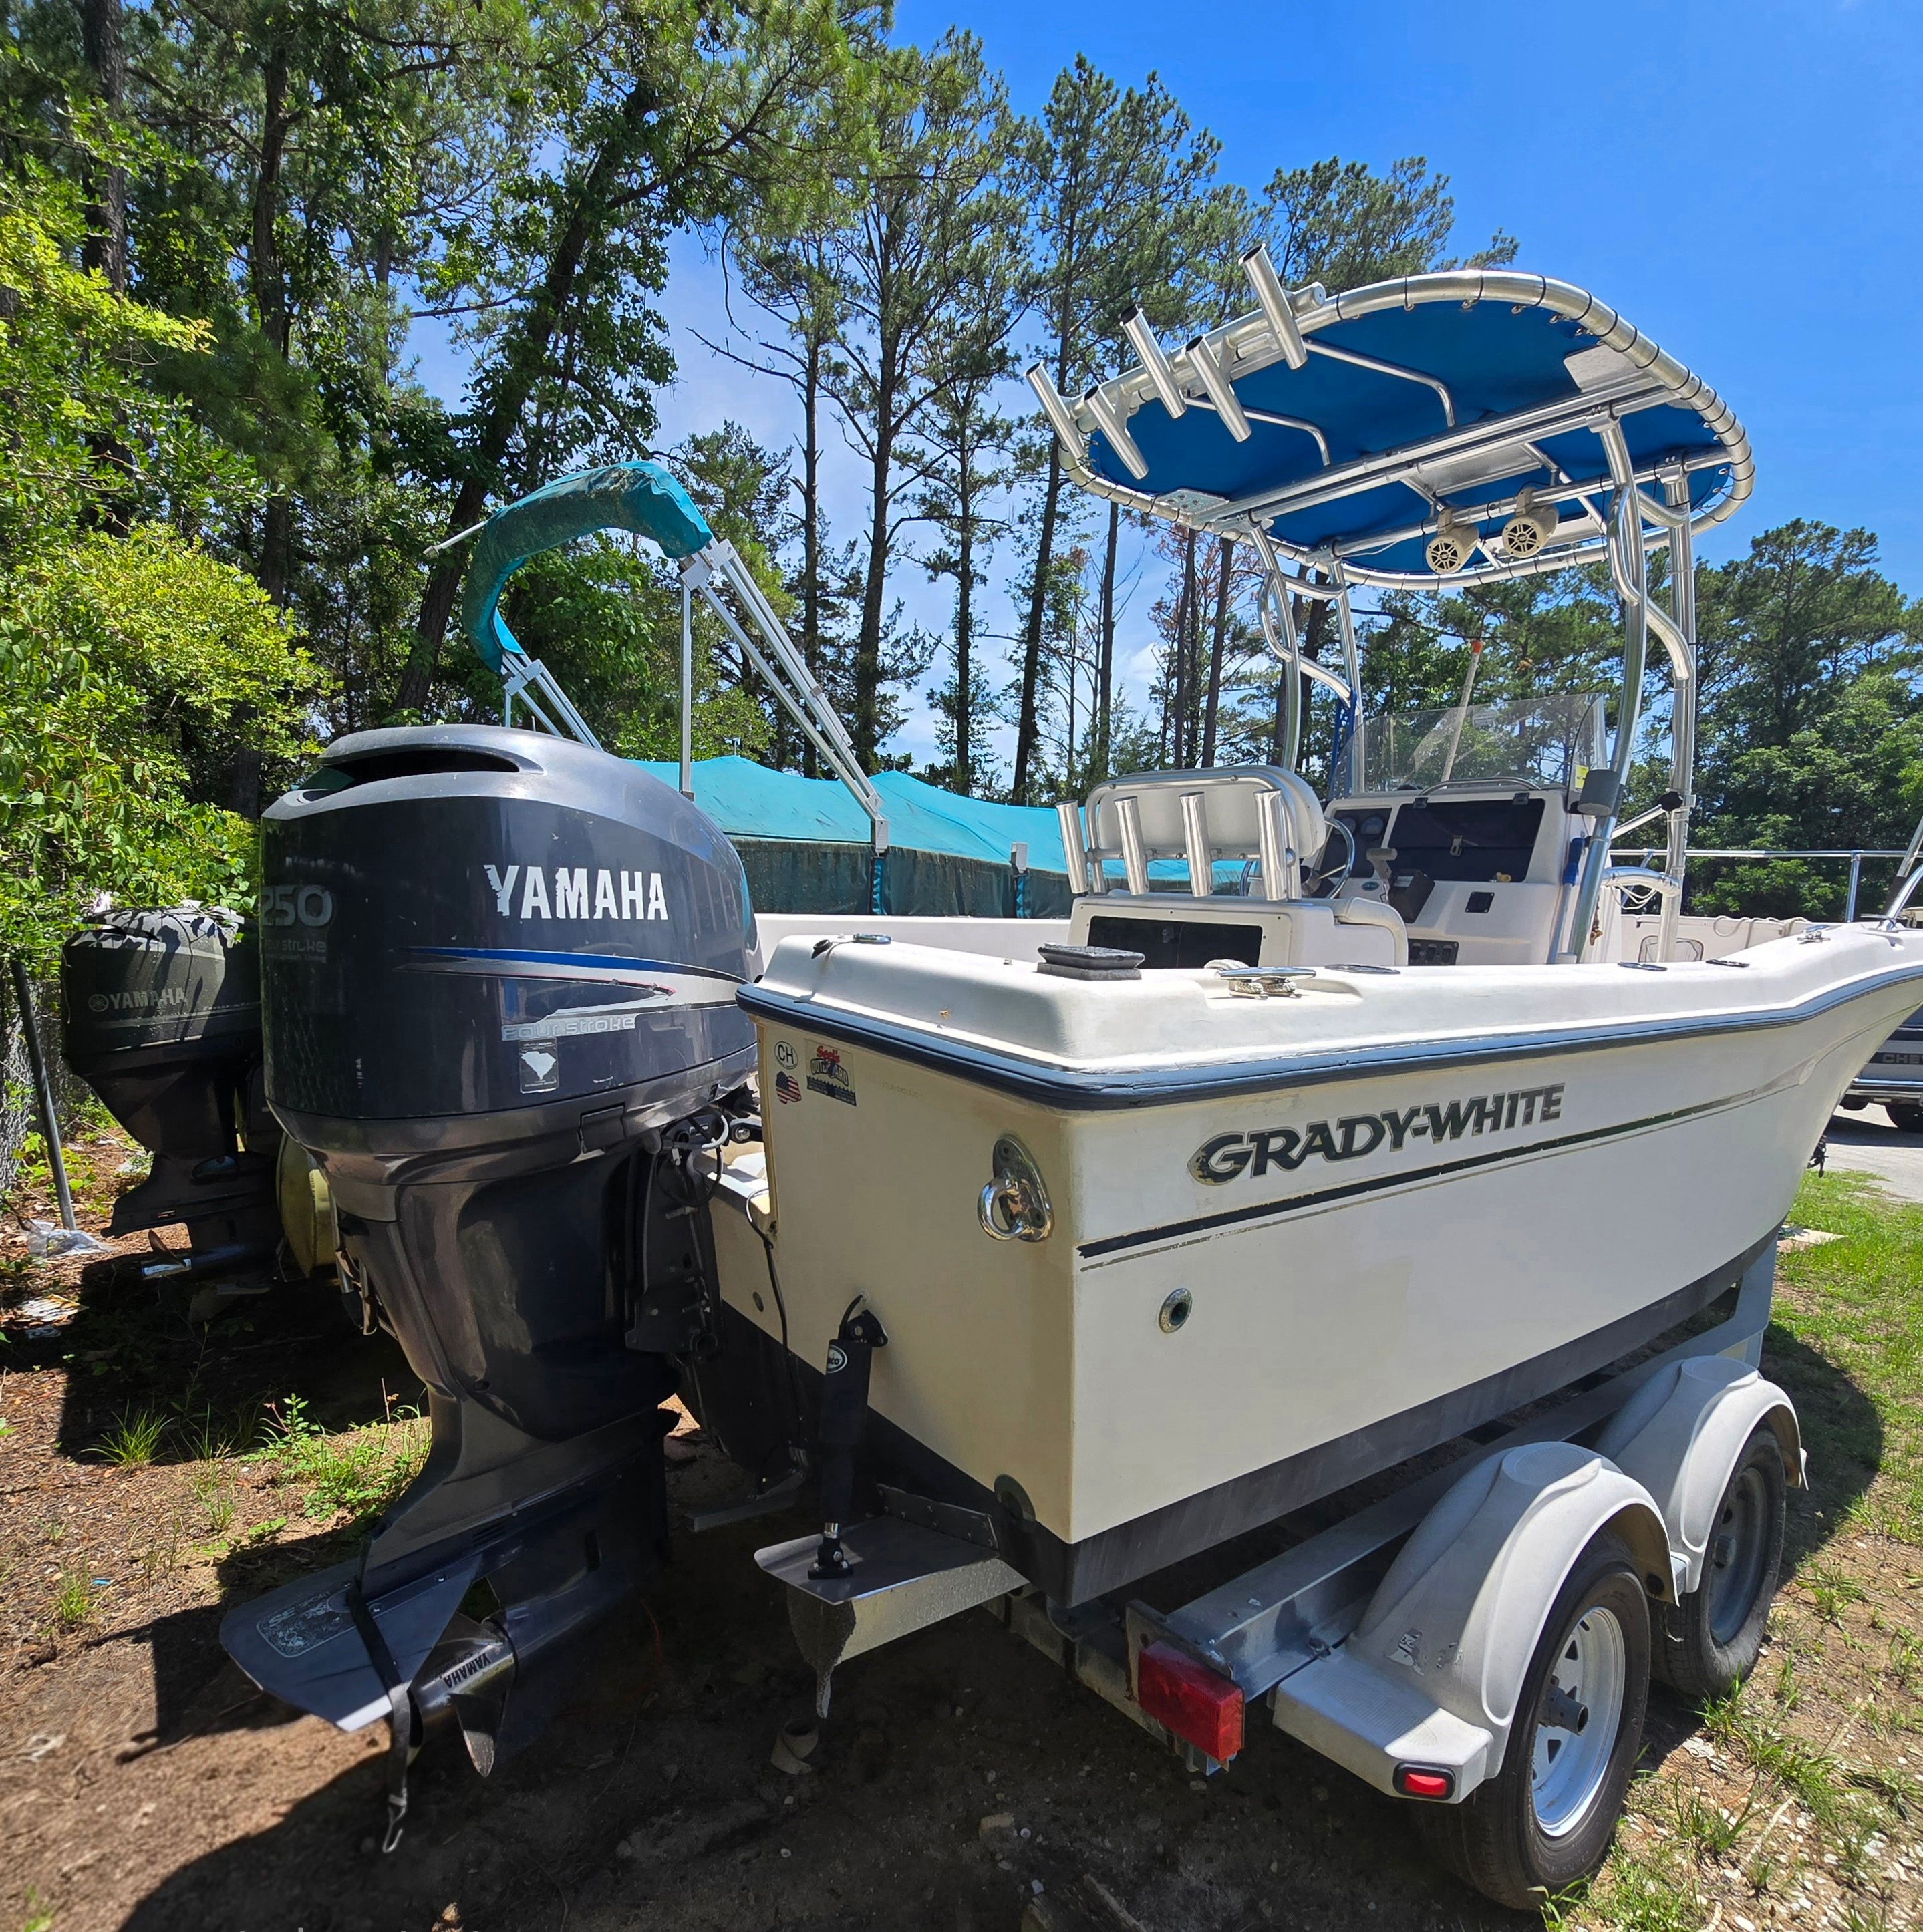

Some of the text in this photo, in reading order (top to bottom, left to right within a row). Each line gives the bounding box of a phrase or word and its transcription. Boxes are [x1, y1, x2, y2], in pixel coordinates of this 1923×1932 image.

[262, 884, 333, 927] 250
[484, 864, 669, 921] YAMAHA
[110, 987, 187, 1009] YAMAHA
[778, 1044, 794, 1064] CH
[1882, 1054, 1923, 1064] CHE
[1188, 1082, 1566, 1186] GRADY-WHITE
[444, 1653, 492, 1689] YAMAHA
